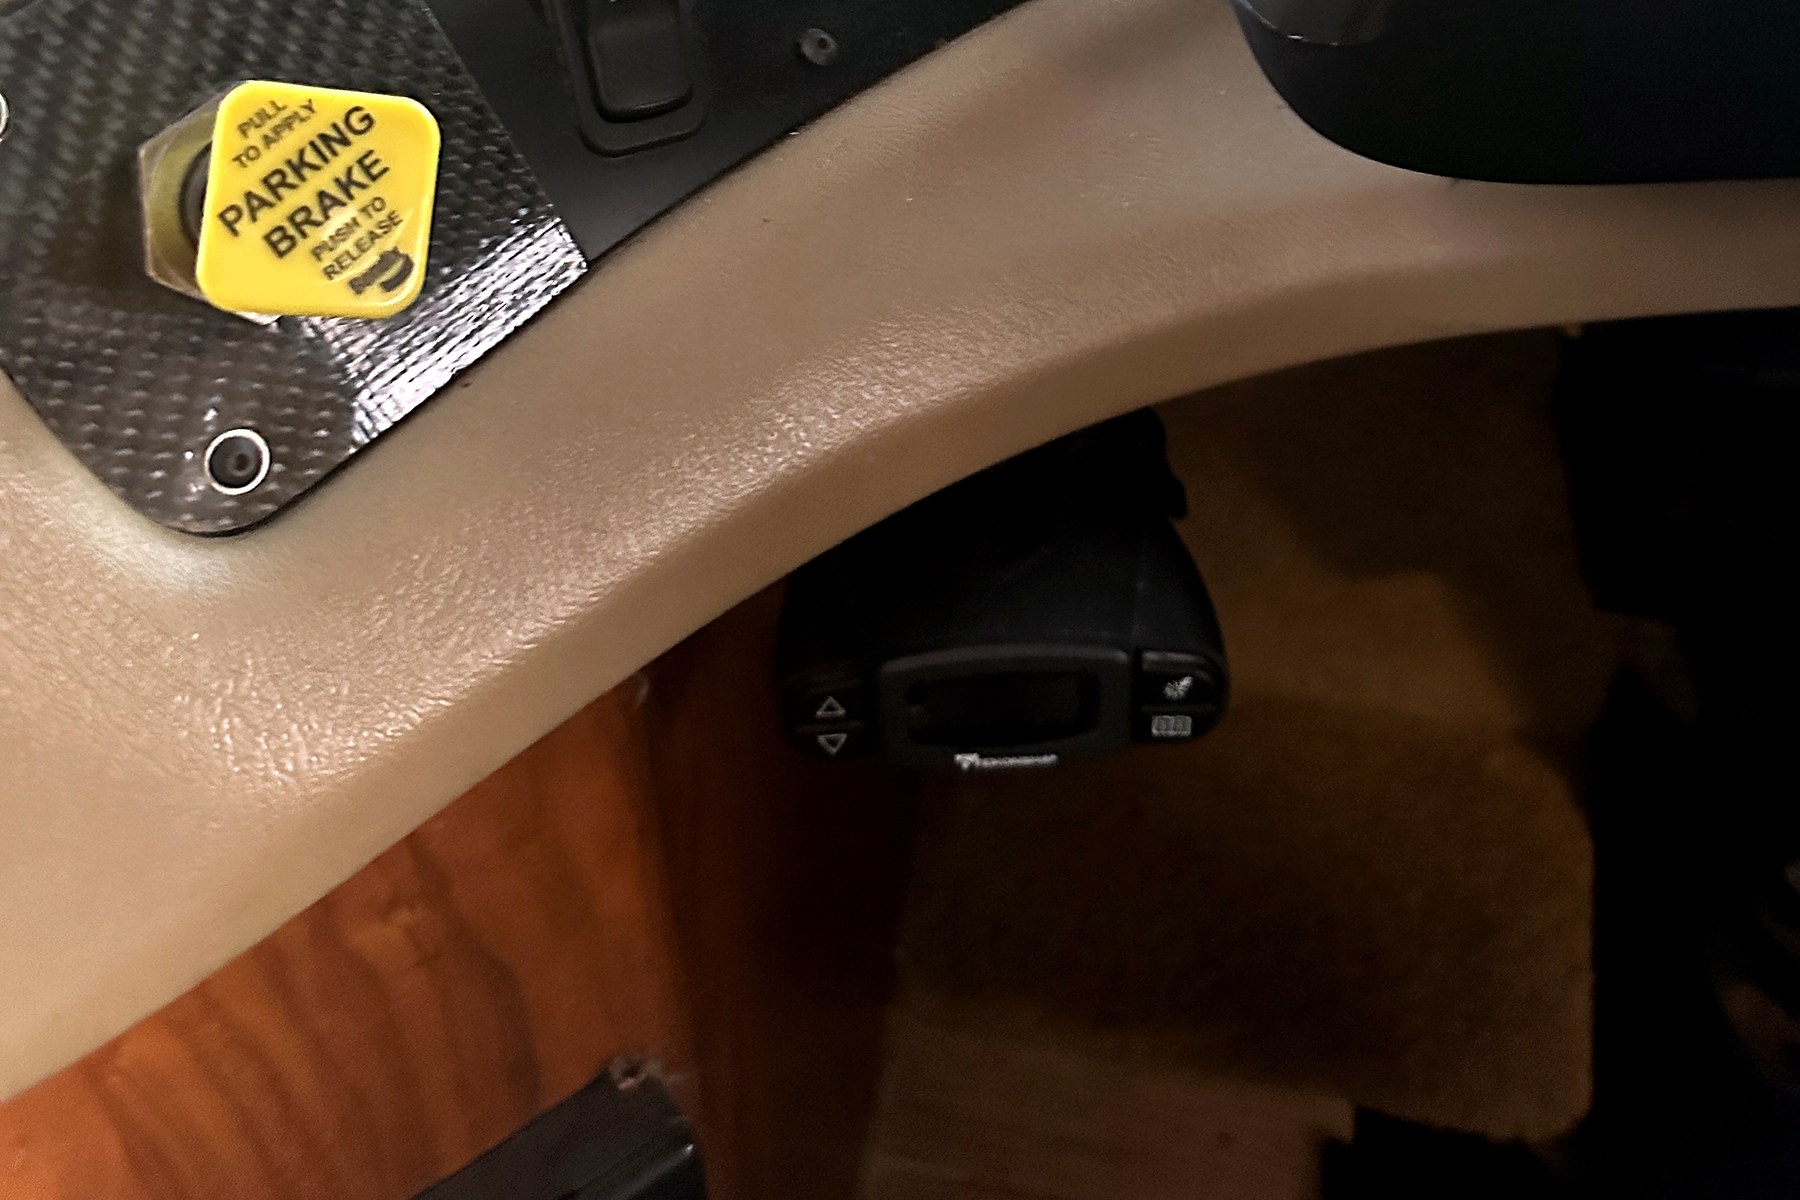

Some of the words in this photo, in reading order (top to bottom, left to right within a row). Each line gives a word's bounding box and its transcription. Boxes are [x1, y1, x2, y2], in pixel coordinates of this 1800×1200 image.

[231, 146, 260, 168] TO
[262, 98, 316, 150] APPLY
[237, 100, 288, 138] PULL
[217, 105, 375, 237] PARKING
[263, 149, 390, 259] BRAKE
[312, 217, 360, 261] PUSH
[359, 197, 386, 218] TO
[323, 210, 403, 280] RELEASE
